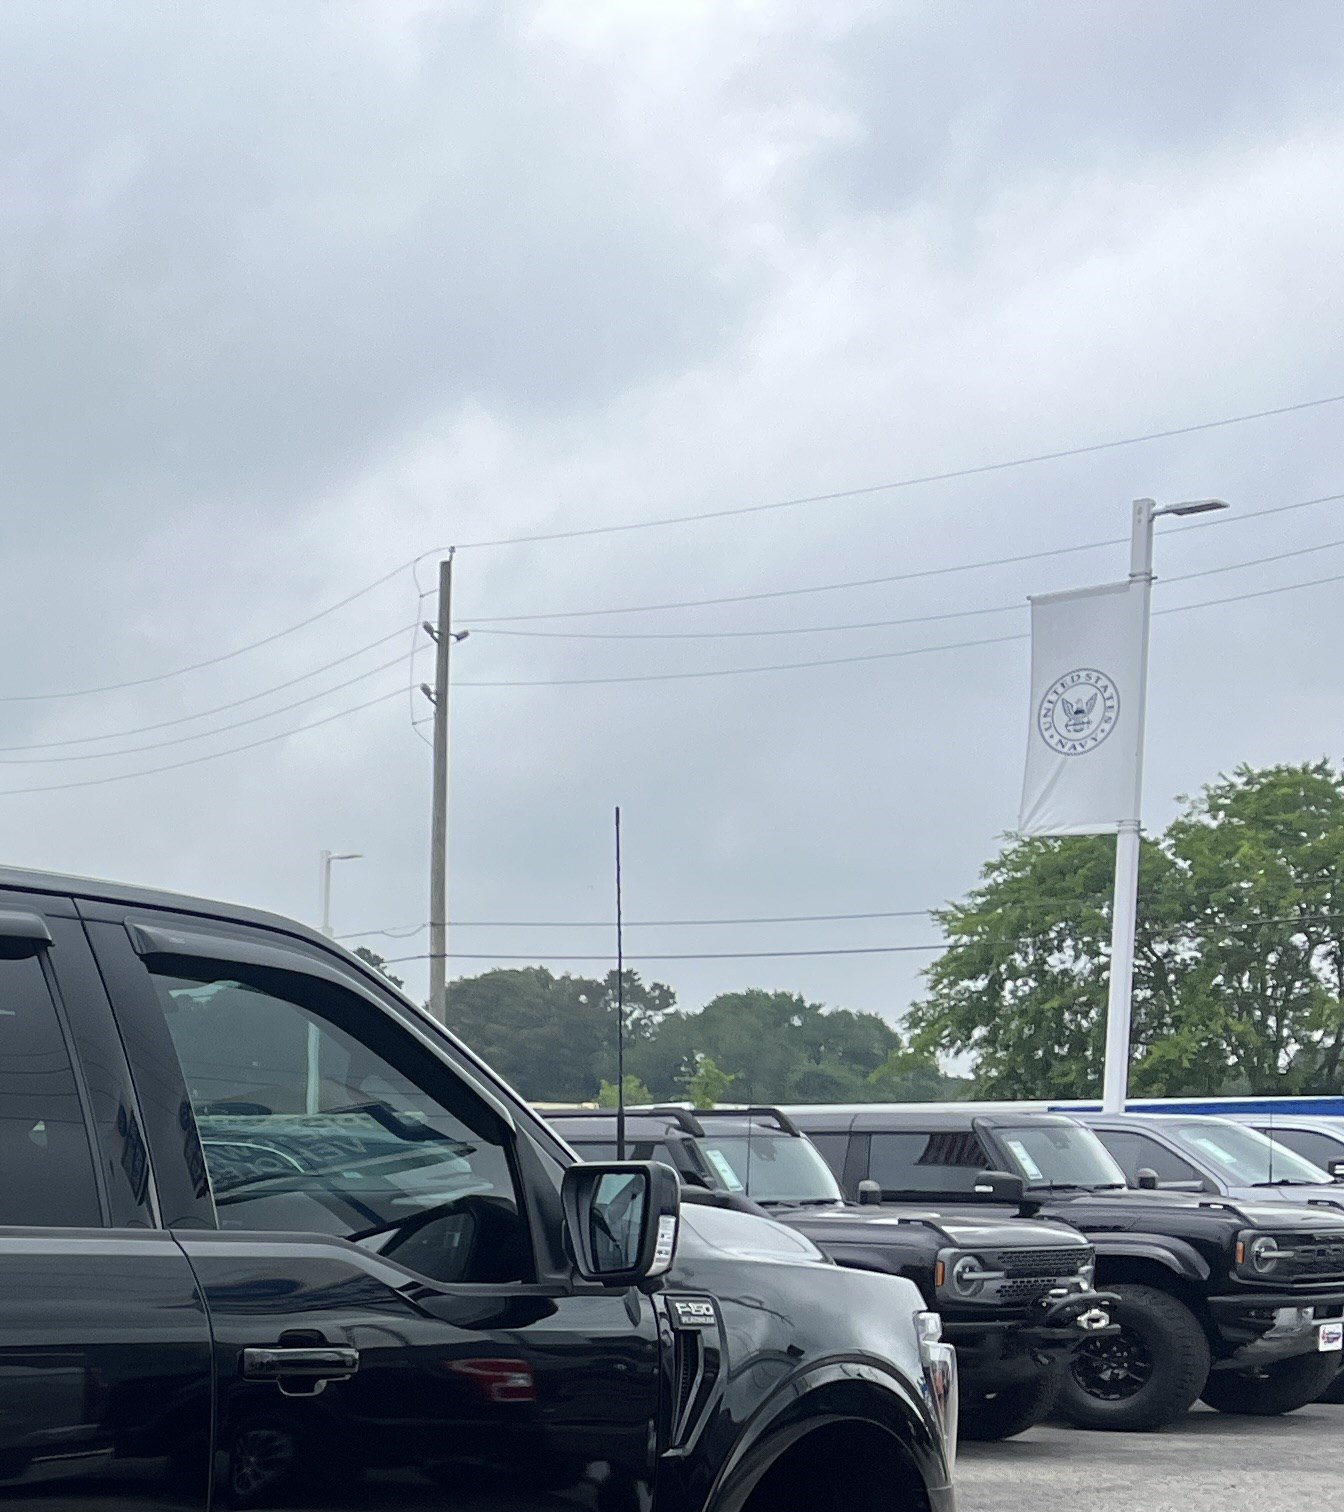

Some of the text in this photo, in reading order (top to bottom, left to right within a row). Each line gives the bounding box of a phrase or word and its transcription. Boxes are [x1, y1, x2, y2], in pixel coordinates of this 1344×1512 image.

[1043, 673, 1115, 732] UNITED STATES
[1056, 735, 1099, 752] NAVY
[675, 1302, 714, 1315] F-150
